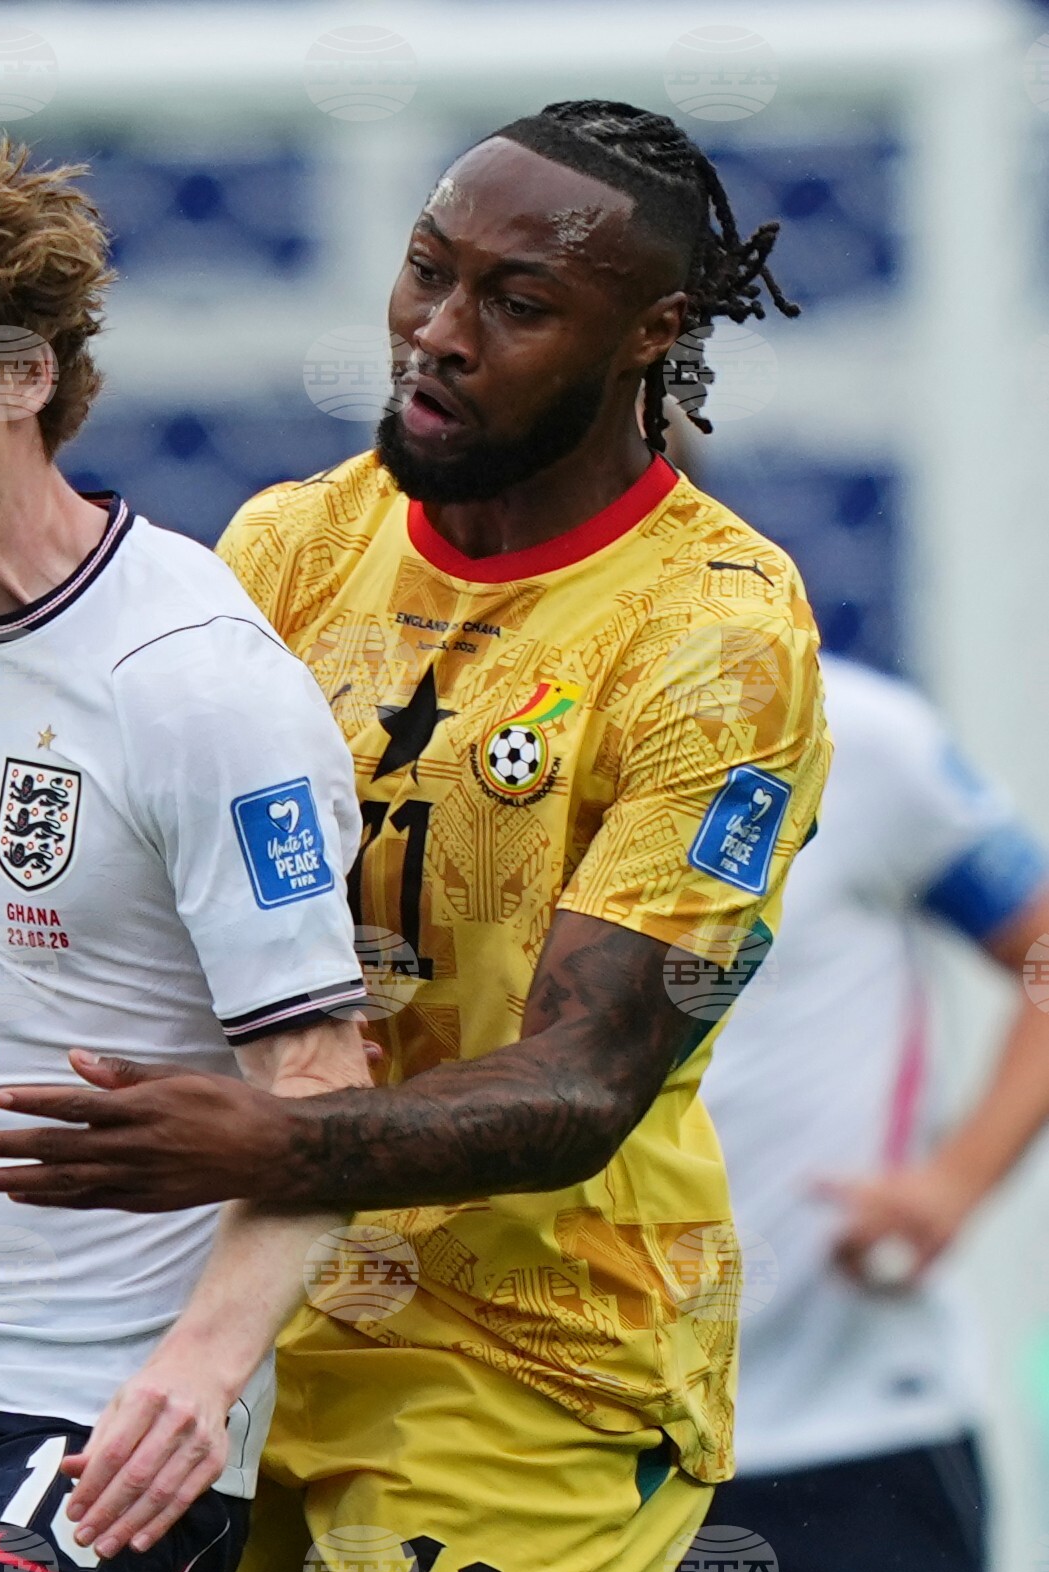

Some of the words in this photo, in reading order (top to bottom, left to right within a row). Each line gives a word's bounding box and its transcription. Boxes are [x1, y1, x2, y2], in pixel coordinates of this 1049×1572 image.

[396, 612, 449, 632] ENGLAND
[275, 850, 320, 880] PEACE
[290, 873, 316, 889] FIFA
[7, 902, 61, 927] GHANA
[7, 927, 69, 949] 23.06.26
